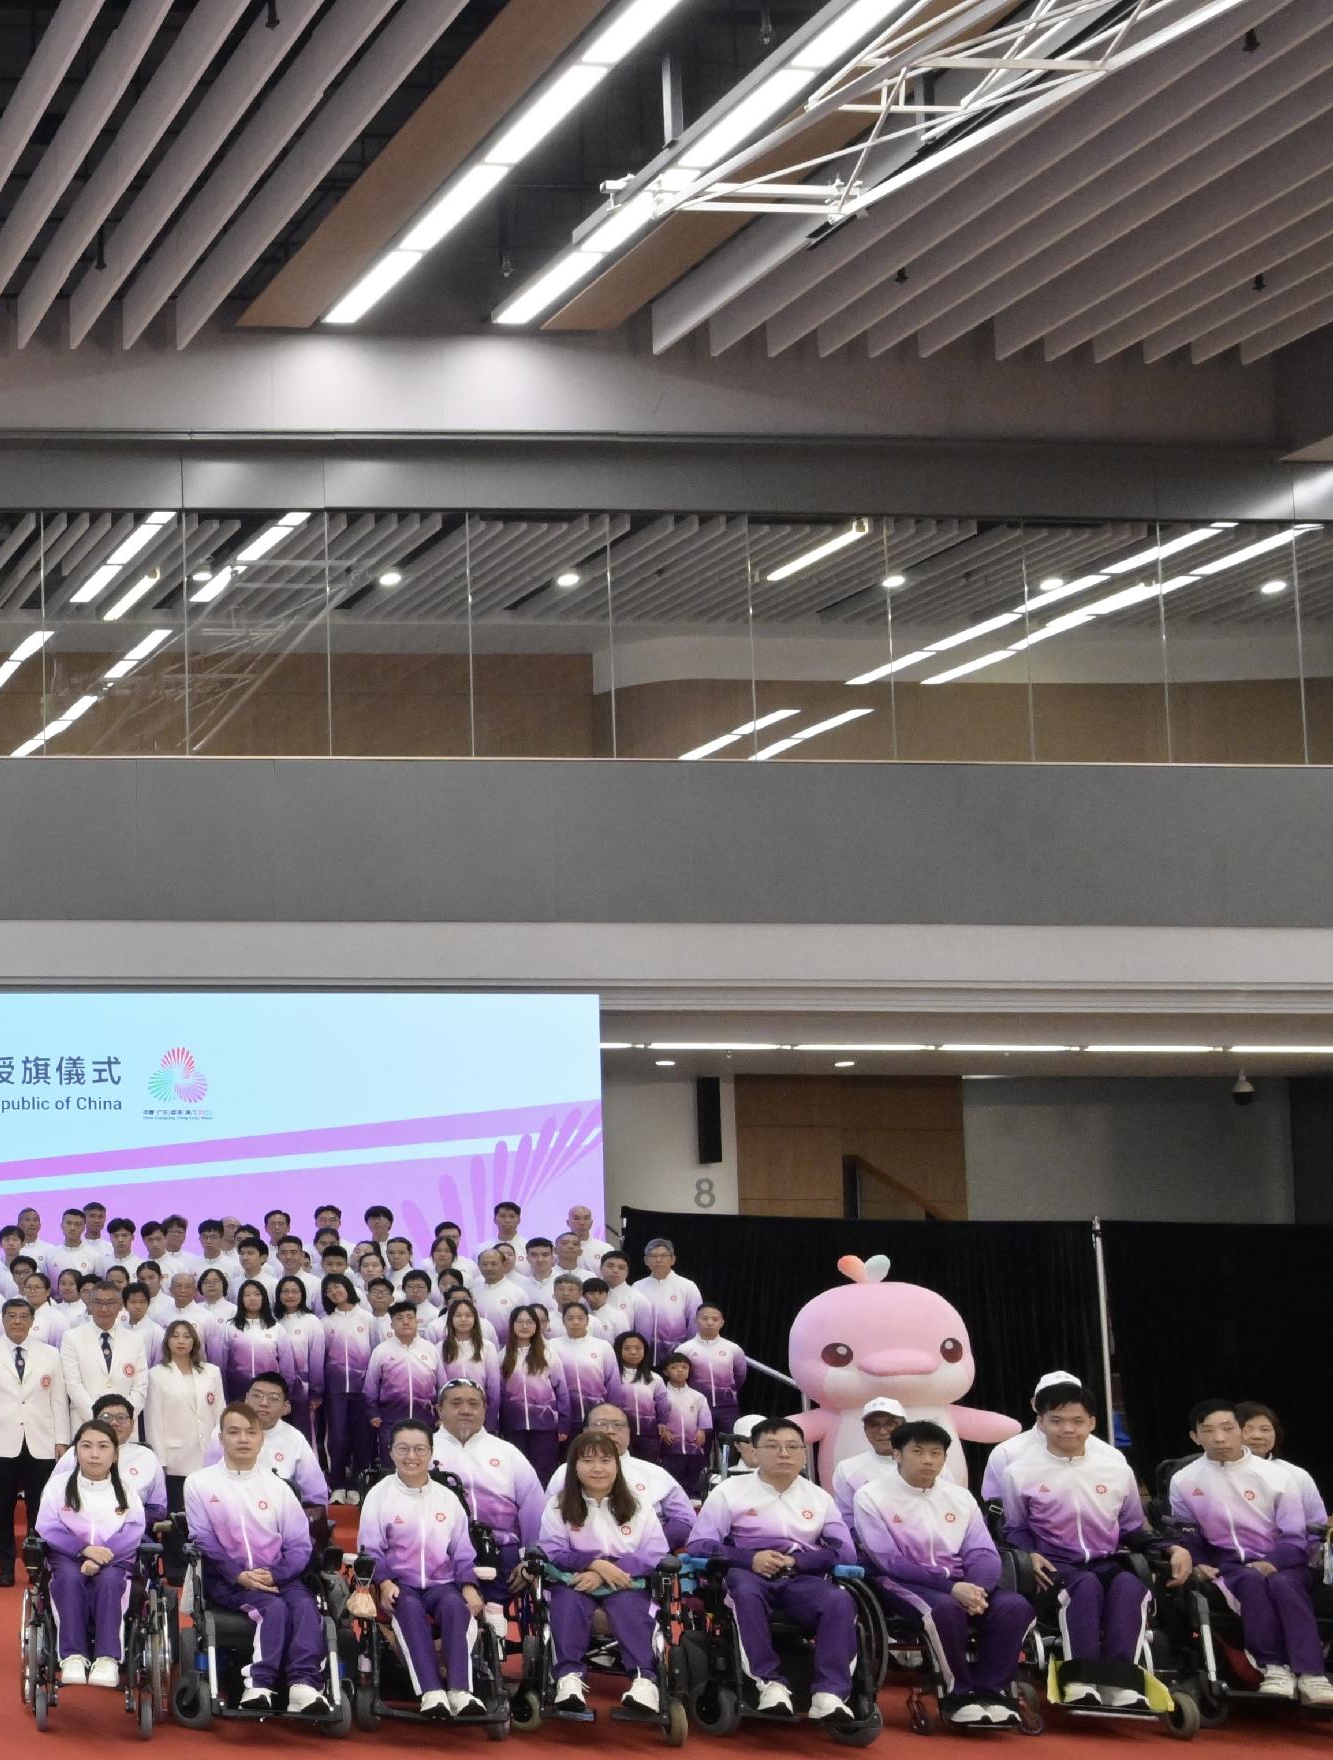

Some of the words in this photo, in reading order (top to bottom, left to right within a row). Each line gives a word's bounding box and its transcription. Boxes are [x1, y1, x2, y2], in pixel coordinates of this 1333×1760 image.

[54, 1095, 72, 1111] of
[76, 1096, 122, 1111] China
[694, 1178, 716, 1209] 8
